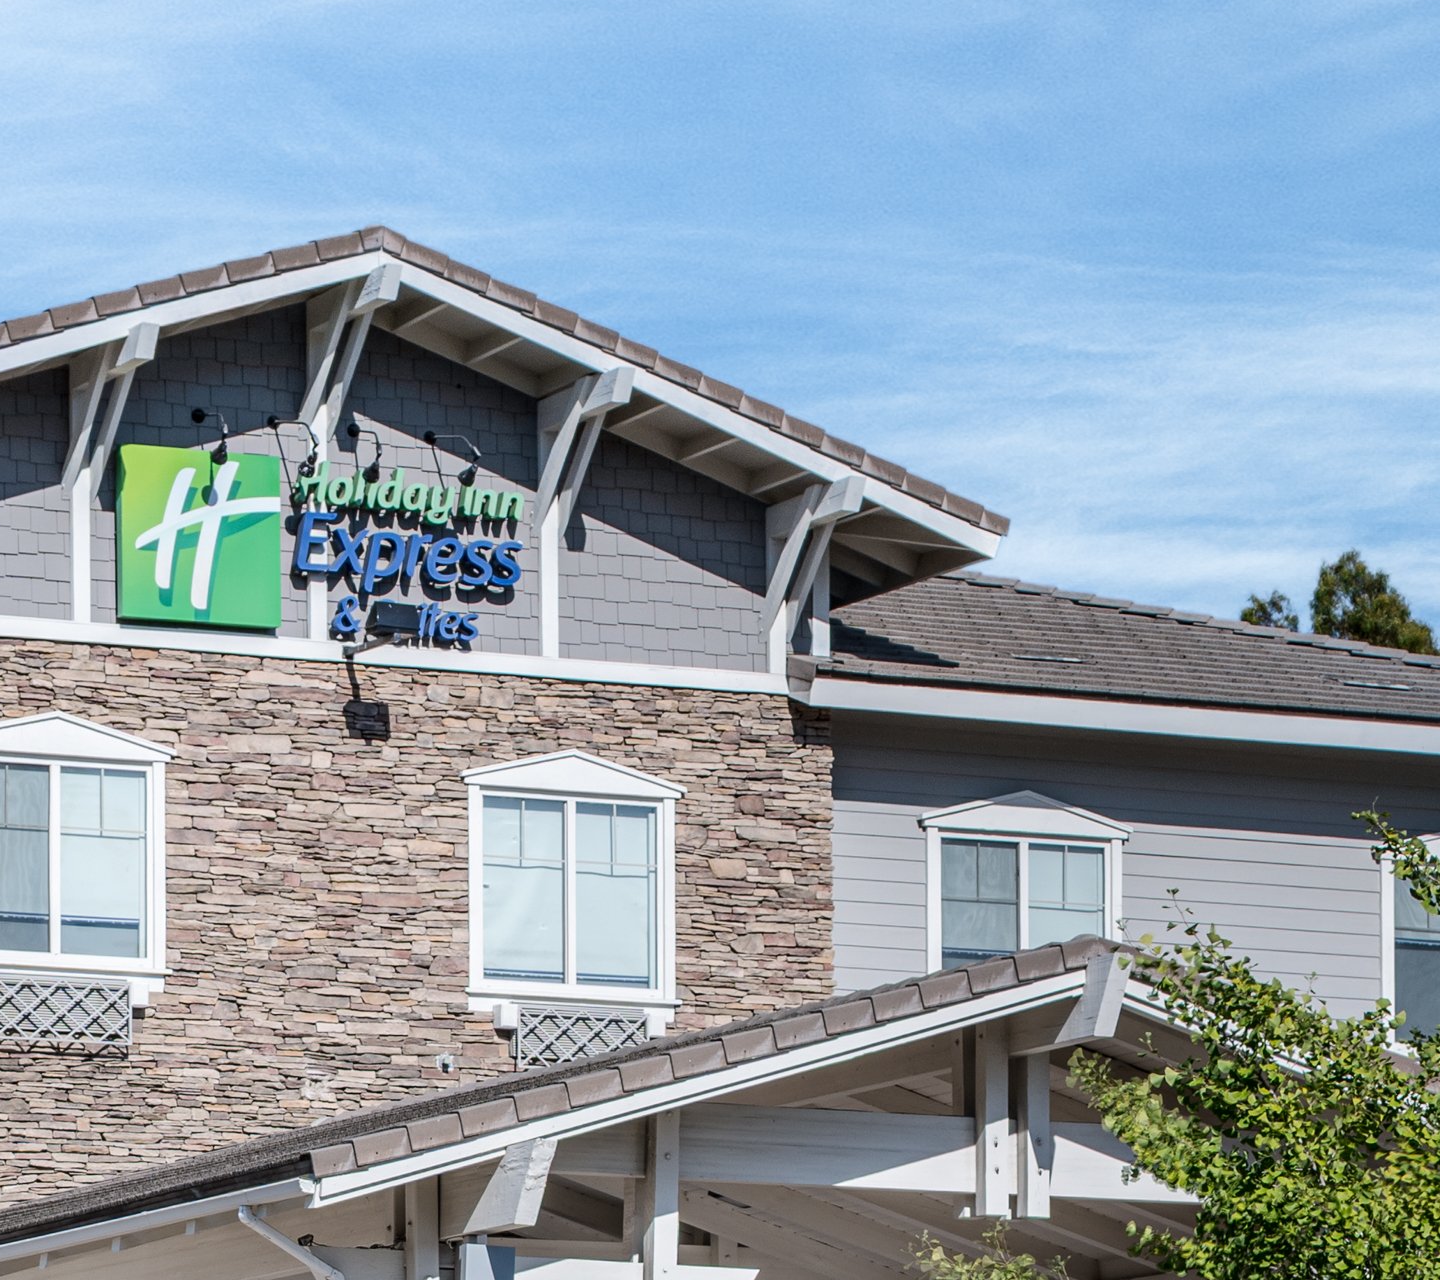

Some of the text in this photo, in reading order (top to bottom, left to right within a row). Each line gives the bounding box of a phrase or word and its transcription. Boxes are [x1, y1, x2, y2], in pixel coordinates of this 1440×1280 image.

[295, 461, 525, 527] Holiday Inn
[296, 511, 524, 593] Express
[331, 595, 480, 641] & ites
